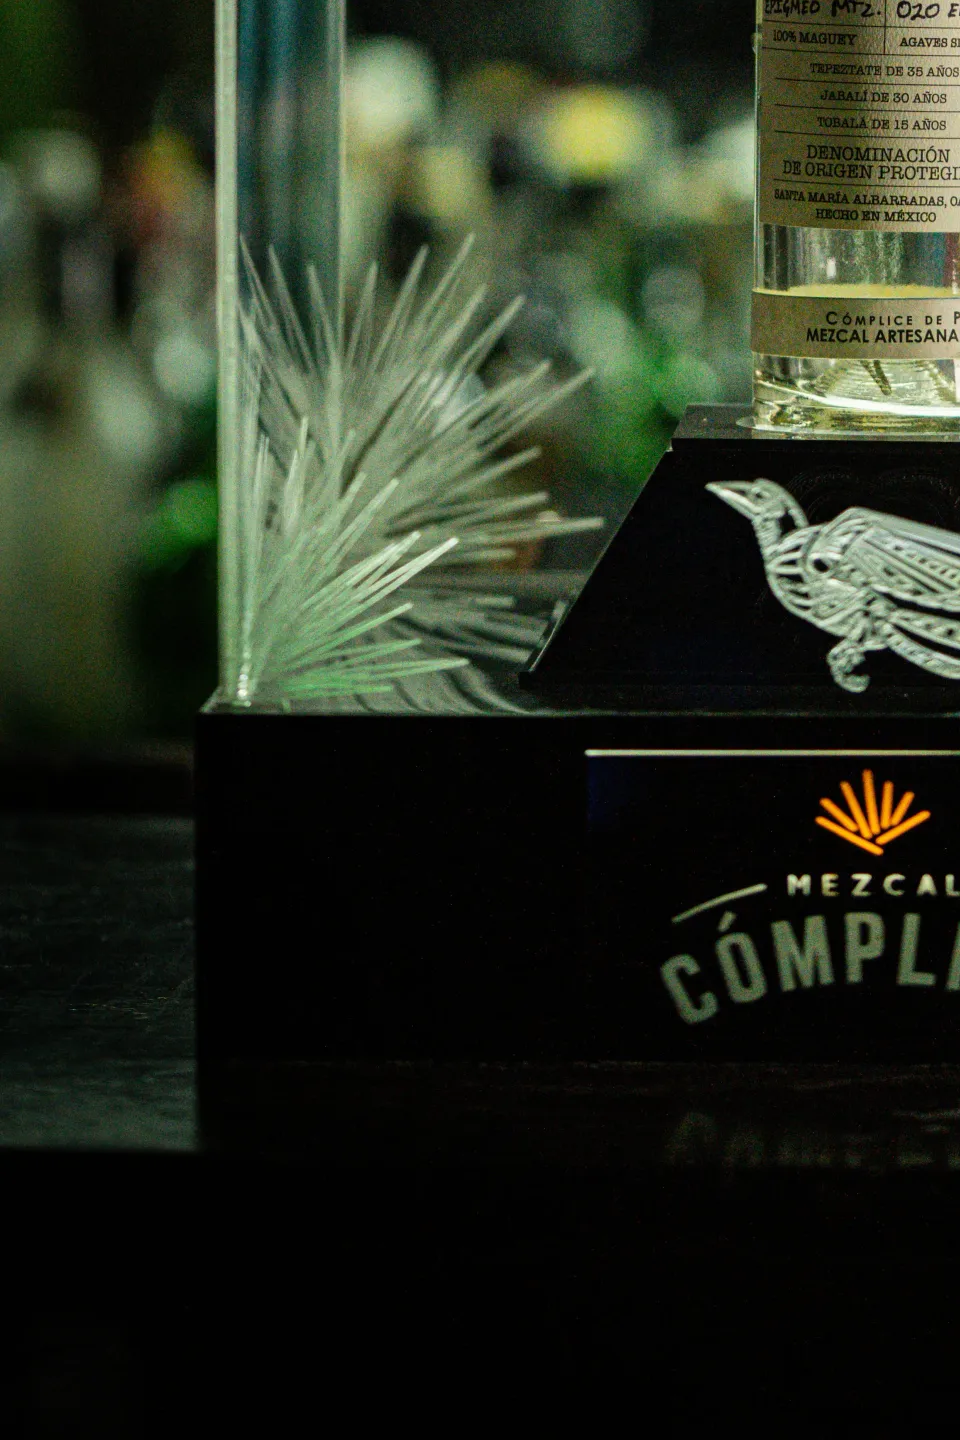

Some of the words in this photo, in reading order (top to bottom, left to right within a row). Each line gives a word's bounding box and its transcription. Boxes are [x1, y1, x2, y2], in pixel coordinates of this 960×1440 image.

[773, 29, 796, 43] 100%
[799, 31, 857, 46] MAGUEY
[900, 37, 948, 48] AGAVES
[810, 62, 882, 76] TEPEZTATE
[884, 66, 904, 77] DE
[907, 66, 923, 77] 35
[926, 64, 960, 78] AÑOS
[820, 89, 868, 103] JABALÍ
[871, 92, 890, 103] DE
[892, 92, 909, 103] 30
[912, 90, 947, 104] AÑOS
[871, 118, 890, 130] DE
[894, 119, 909, 130] 15
[912, 117, 947, 130] AÑOS
[807, 144, 950, 163] DENOMINACIÓN
[783, 160, 802, 175] DE
[805, 161, 873, 179] ORIGEN
[774, 188, 805, 202] SANTA
[808, 191, 849, 204] MARÍA
[853, 193, 947, 208] ALBARRADAS,
[816, 208, 858, 221] HECHO
[862, 210, 880, 221] EN
[884, 208, 937, 223] MÉXICO
[925, 315, 942, 325] DE
[806, 327, 869, 343] MEZCAL
